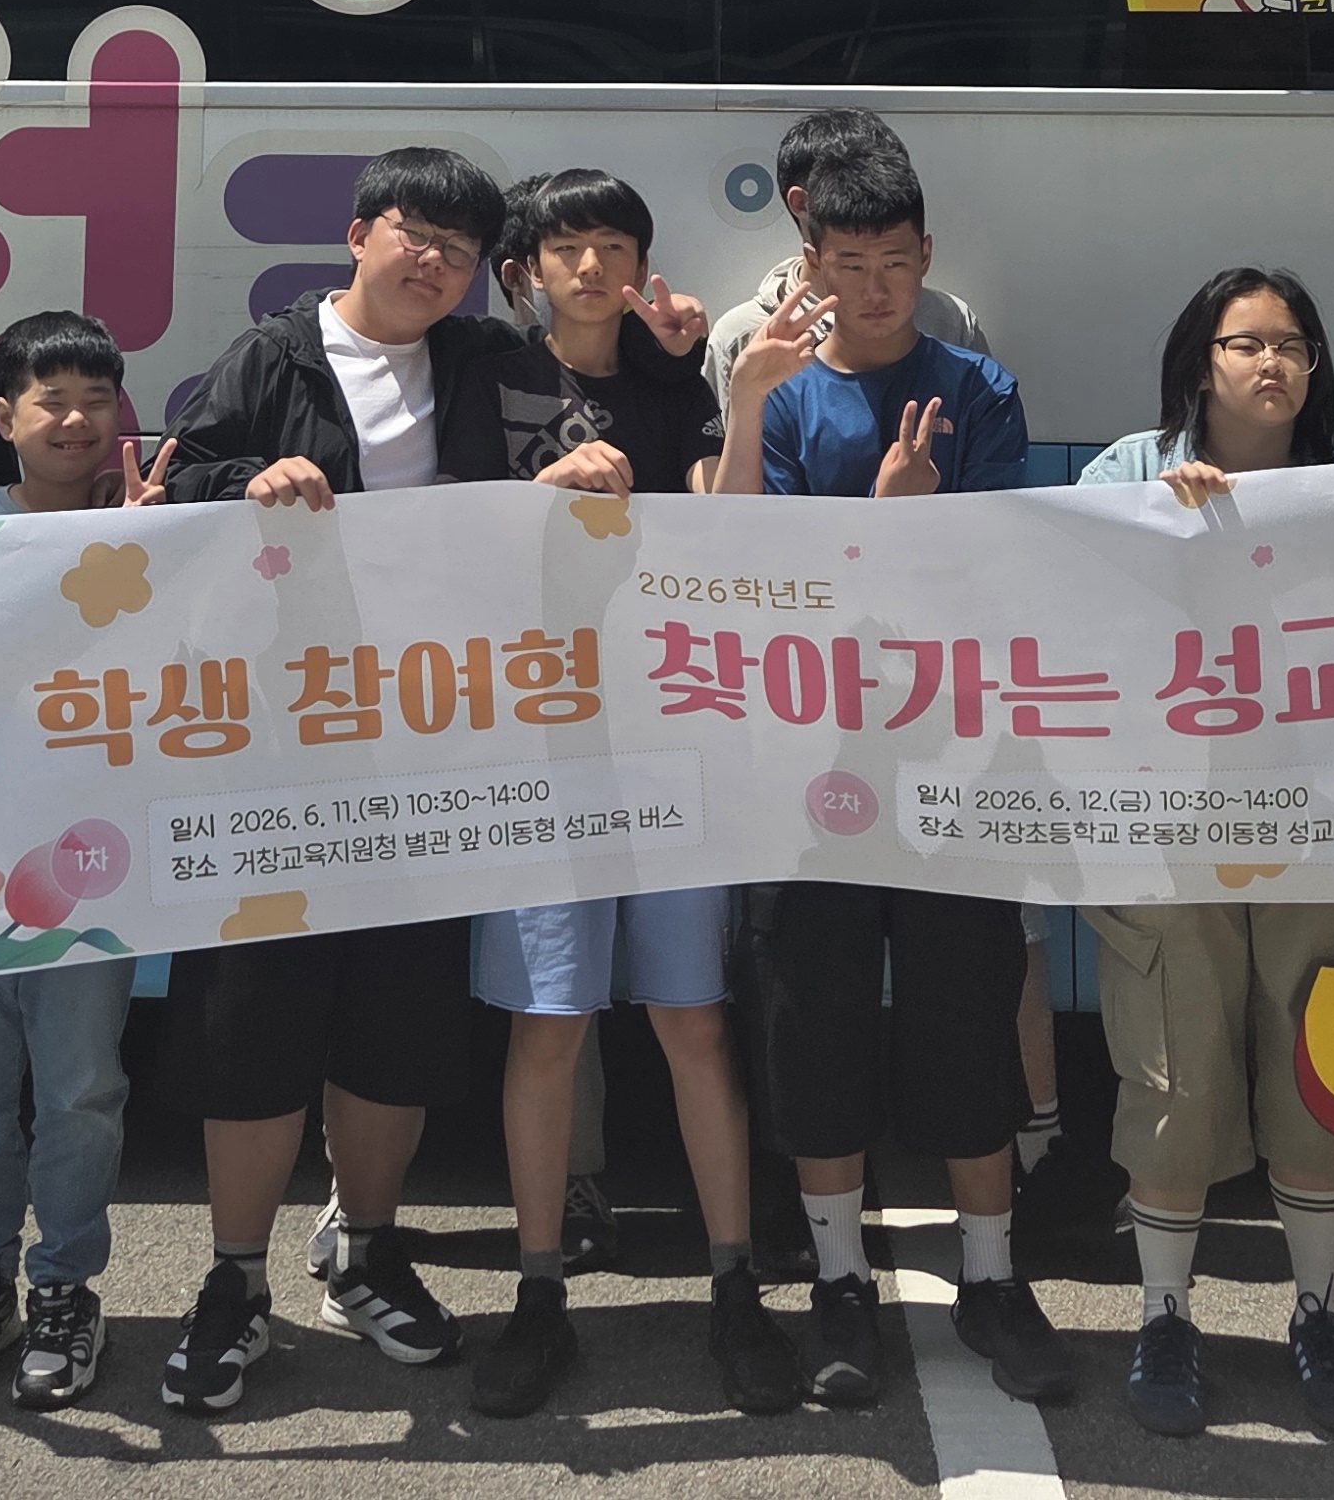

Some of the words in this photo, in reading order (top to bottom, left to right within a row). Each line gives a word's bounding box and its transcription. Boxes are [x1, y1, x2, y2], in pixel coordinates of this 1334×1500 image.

[639, 572, 836, 610] 2026학년도
[33, 657, 252, 767] 학생
[284, 627, 603, 746] 참여형
[644, 619, 1121, 739] 찾아가는
[170, 813, 215, 842] 일시
[230, 807, 297, 835] 2026.
[304, 804, 326, 828] 6.
[332, 794, 399, 824] 11.(목)
[407, 780, 550, 816] 10:30~14:00
[823, 791, 862, 814] 2차
[917, 784, 961, 808] 일시
[975, 790, 1042, 813] 2026.
[1049, 790, 1071, 812] 6.
[1078, 789, 1151, 813] 12.(금)
[1159, 786, 1309, 811] 10:30~14:00
[171, 853, 218, 880] 장소
[233, 833, 397, 876] 거창교육지원청
[405, 829, 452, 857] 별관
[458, 825, 482, 852] 앞
[488, 816, 555, 847] 이동형
[563, 809, 632, 840] 성교육
[639, 804, 685, 830] 버스
[918, 815, 964, 839] 장소
[978, 820, 1120, 844] 거창초등학교
[1128, 821, 1200, 845] 운동장
[1207, 820, 1278, 845] 이동형
[74, 846, 109, 872] 1차
